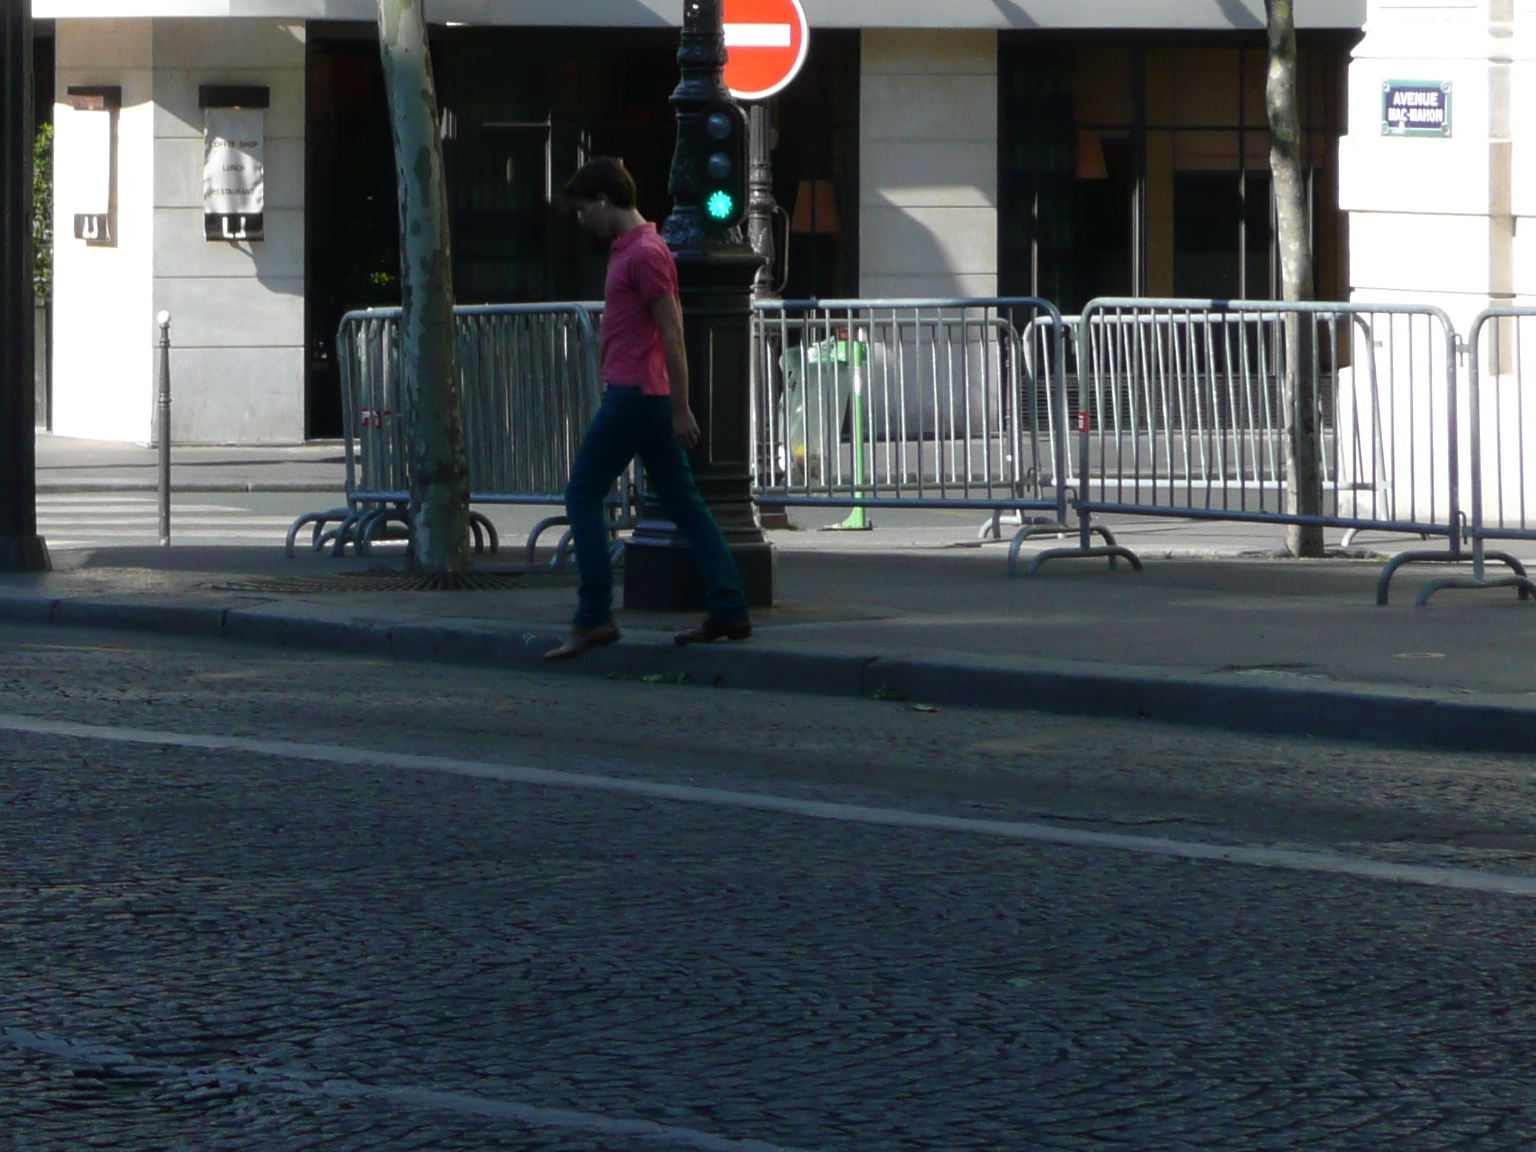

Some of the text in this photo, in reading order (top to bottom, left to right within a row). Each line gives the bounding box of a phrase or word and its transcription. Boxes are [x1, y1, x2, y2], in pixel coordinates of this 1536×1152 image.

[1392, 91, 1439, 106] AVENUE
[1388, 107, 1444, 123] MAC-MAHON
[239, 140, 259, 149] SHOP
[222, 164, 245, 172] LUNCH
[210, 188, 254, 196] RESTAURANT
